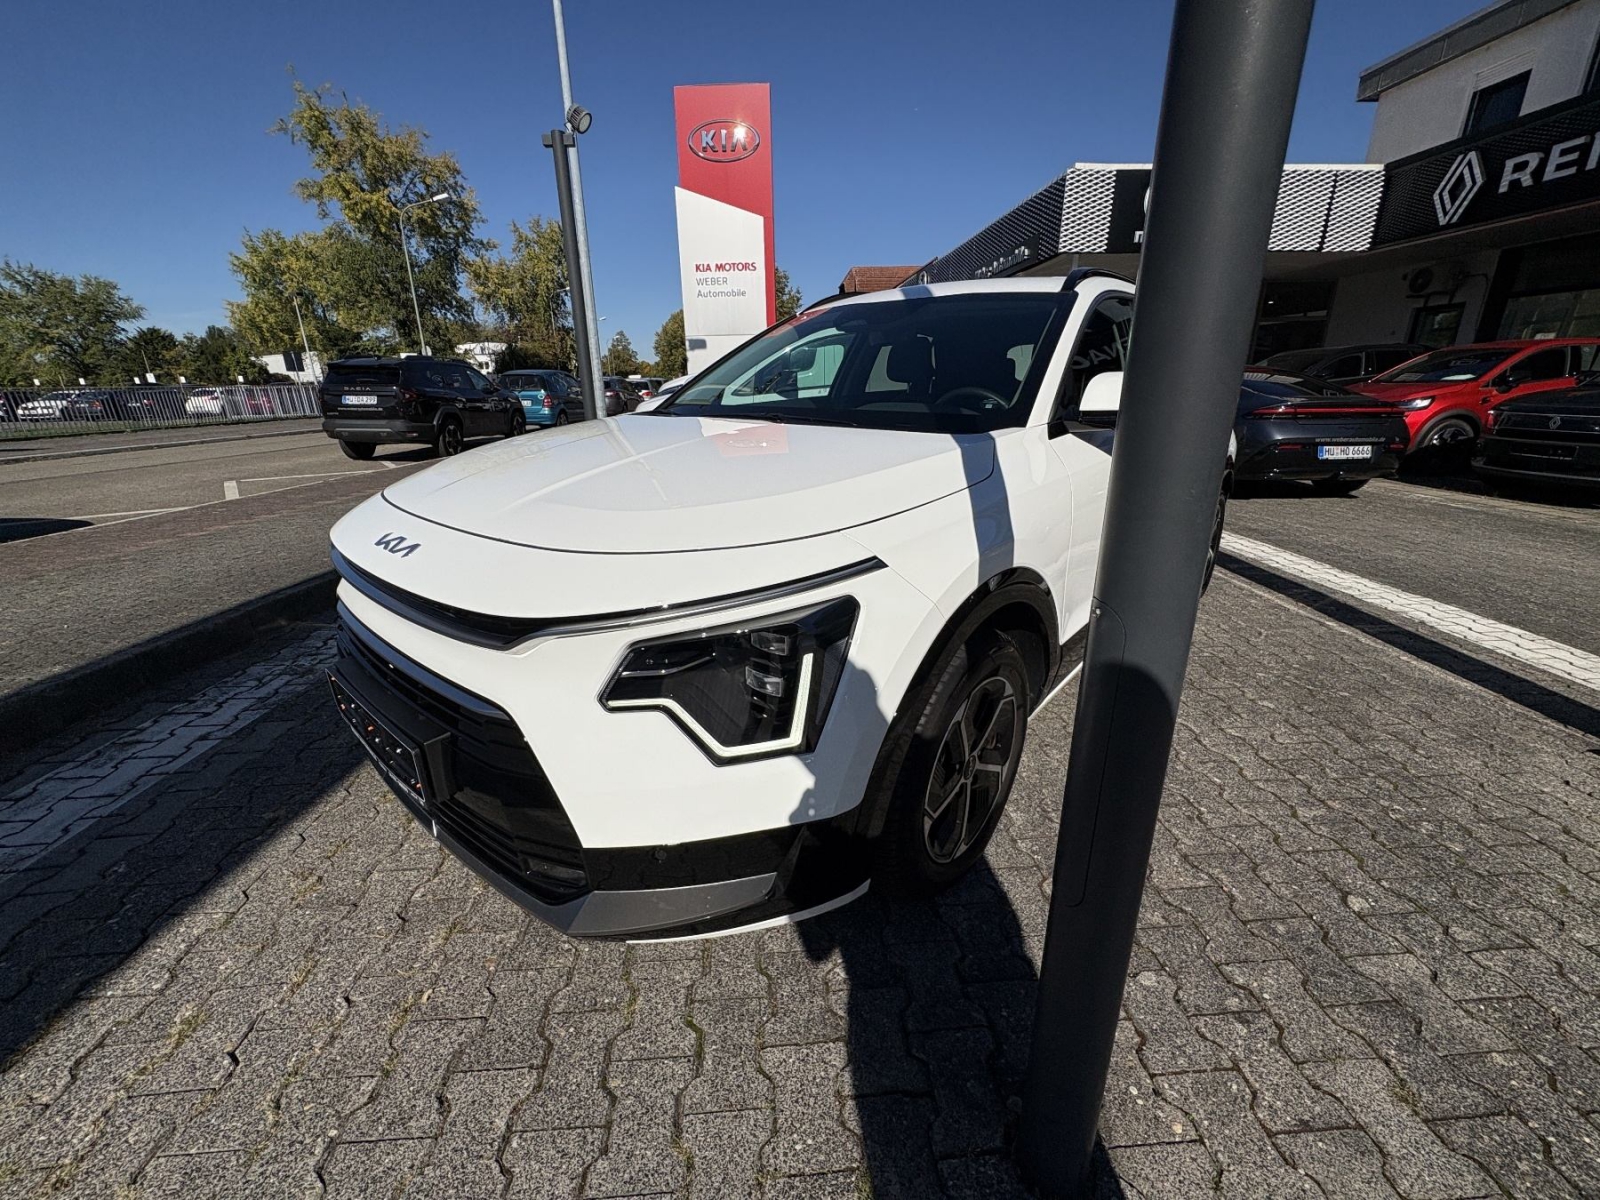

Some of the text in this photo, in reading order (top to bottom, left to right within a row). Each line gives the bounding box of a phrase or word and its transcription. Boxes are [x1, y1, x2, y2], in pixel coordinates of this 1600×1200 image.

[701, 127, 747, 152] KIA
[695, 262, 757, 273] KIA MOTORS
[696, 277, 728, 286] WEBER
[697, 289, 746, 298] Automobile
[1325, 447, 1335, 456] HU
[1351, 447, 1370, 456] 6666
